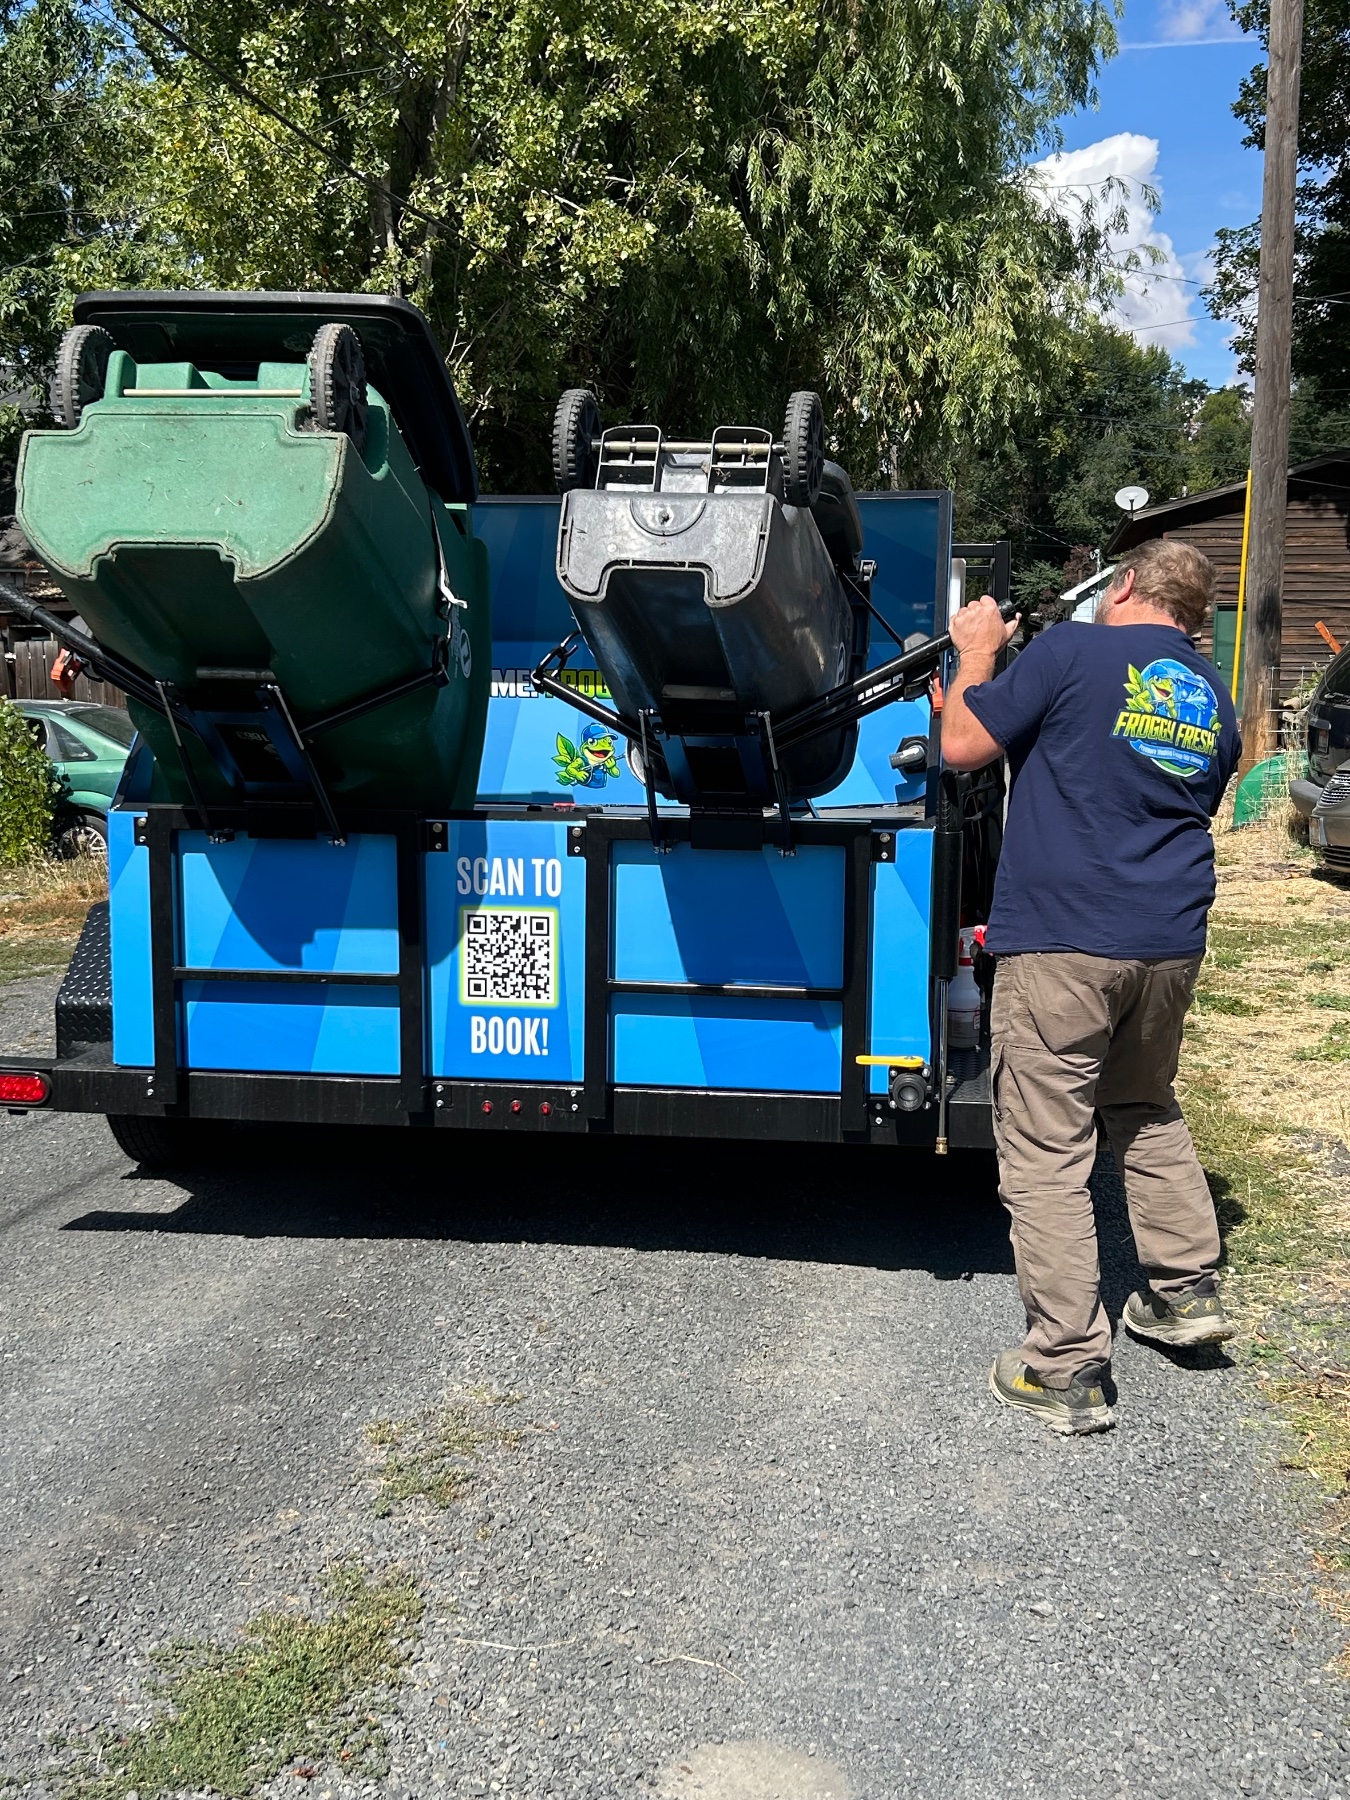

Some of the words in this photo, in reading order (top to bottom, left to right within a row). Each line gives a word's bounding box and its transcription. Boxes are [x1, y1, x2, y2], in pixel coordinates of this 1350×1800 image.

[1112, 711, 1177, 744] FROGGY
[456, 856, 525, 896] SCAN
[531, 857, 562, 897] TO
[470, 1015, 549, 1056] BOOK!
